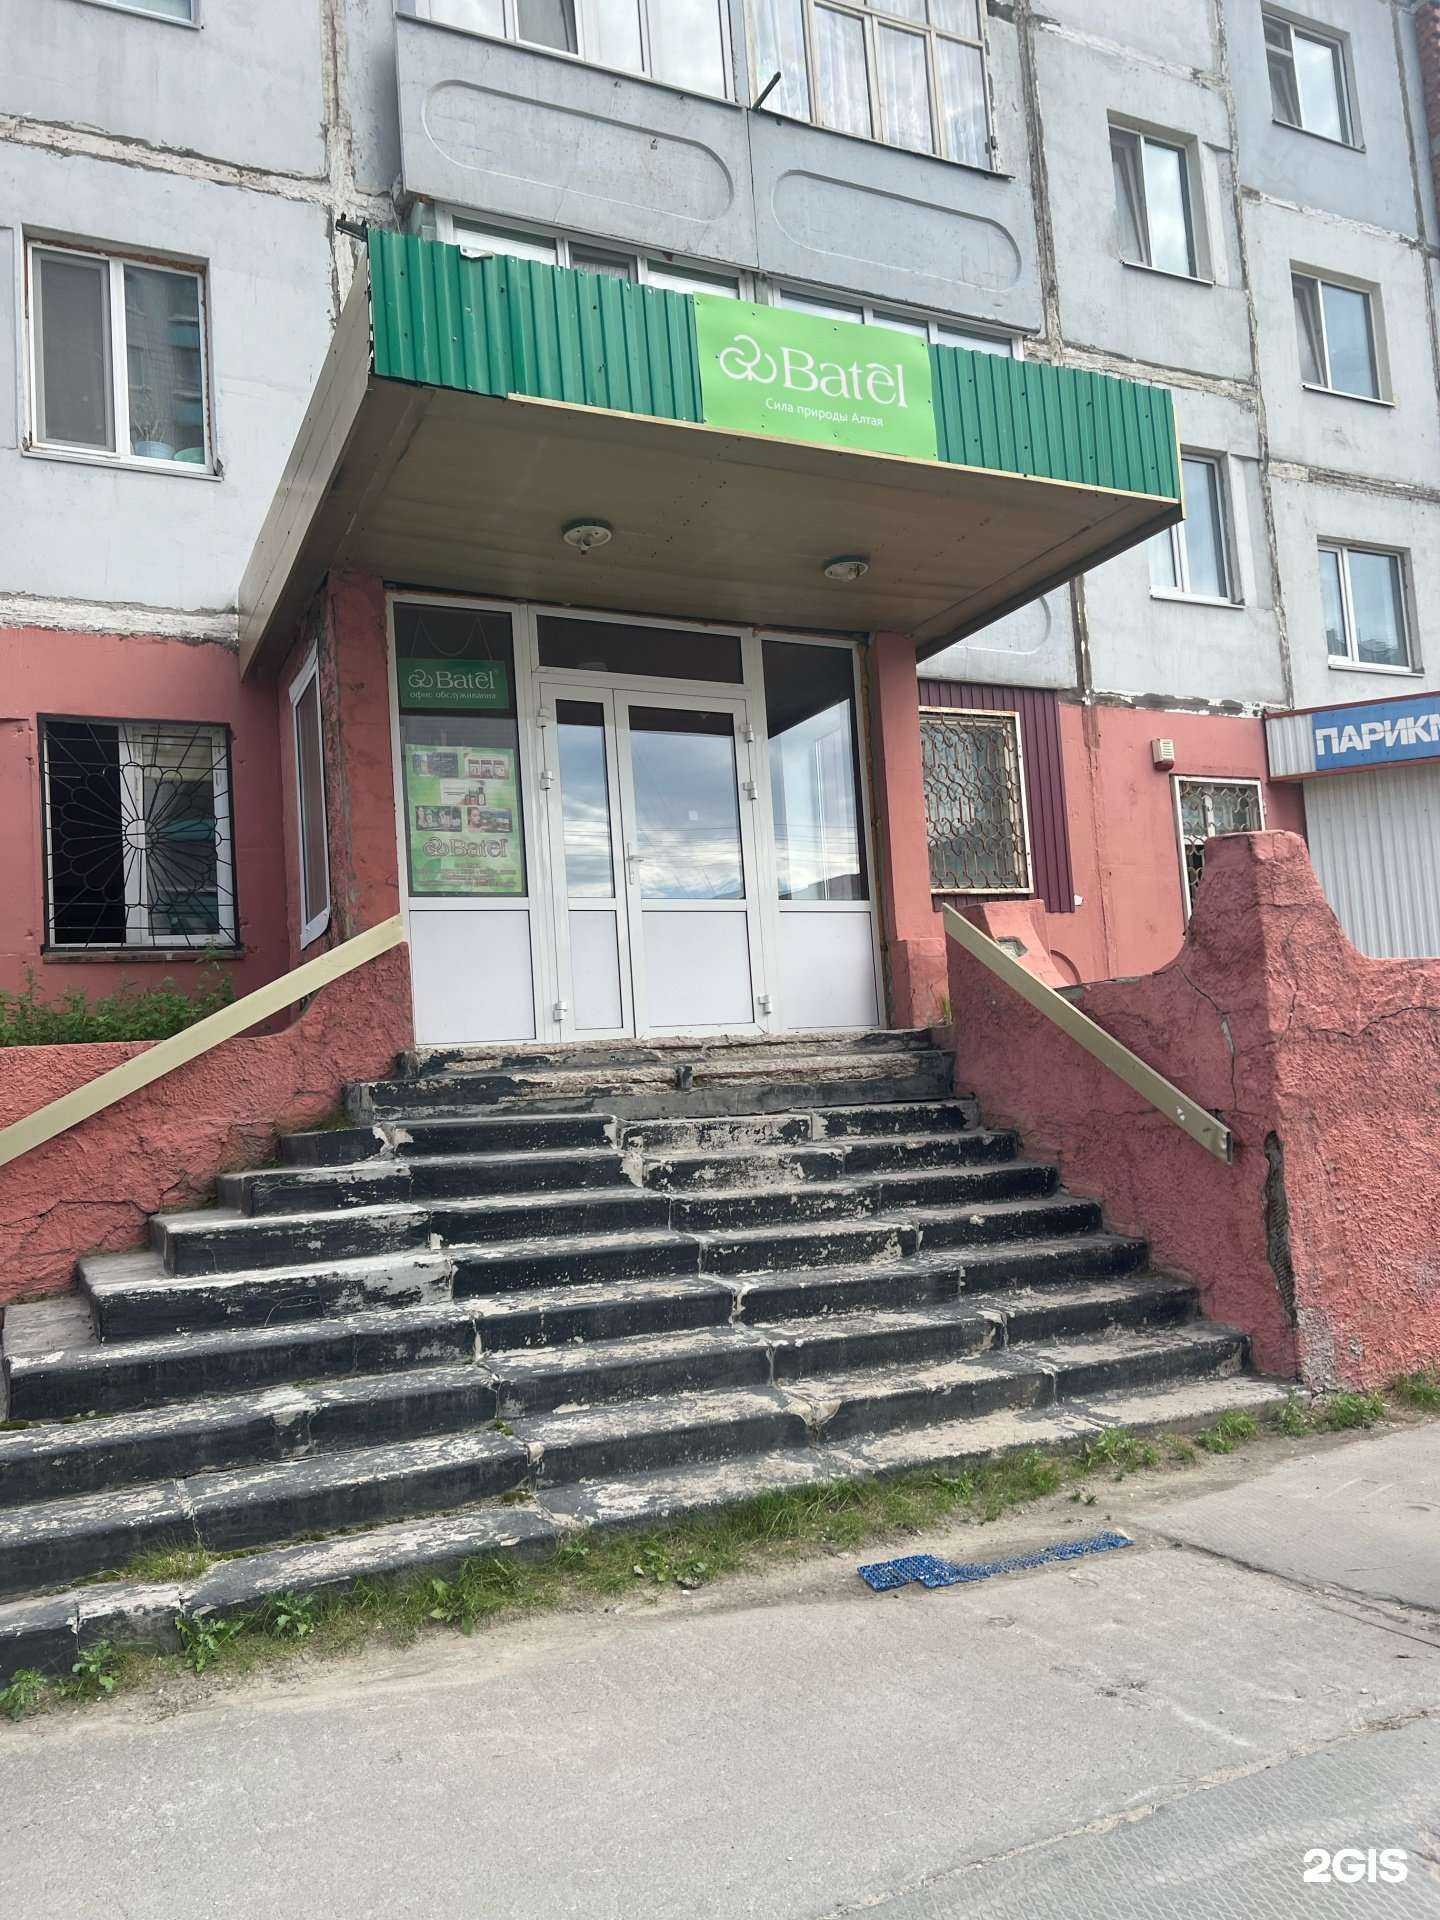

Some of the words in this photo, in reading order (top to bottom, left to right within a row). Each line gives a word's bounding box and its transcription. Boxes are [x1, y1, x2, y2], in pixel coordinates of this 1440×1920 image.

[765, 398, 794, 413] Сила
[797, 404, 848, 423] природы
[851, 412, 884, 427] Алтая
